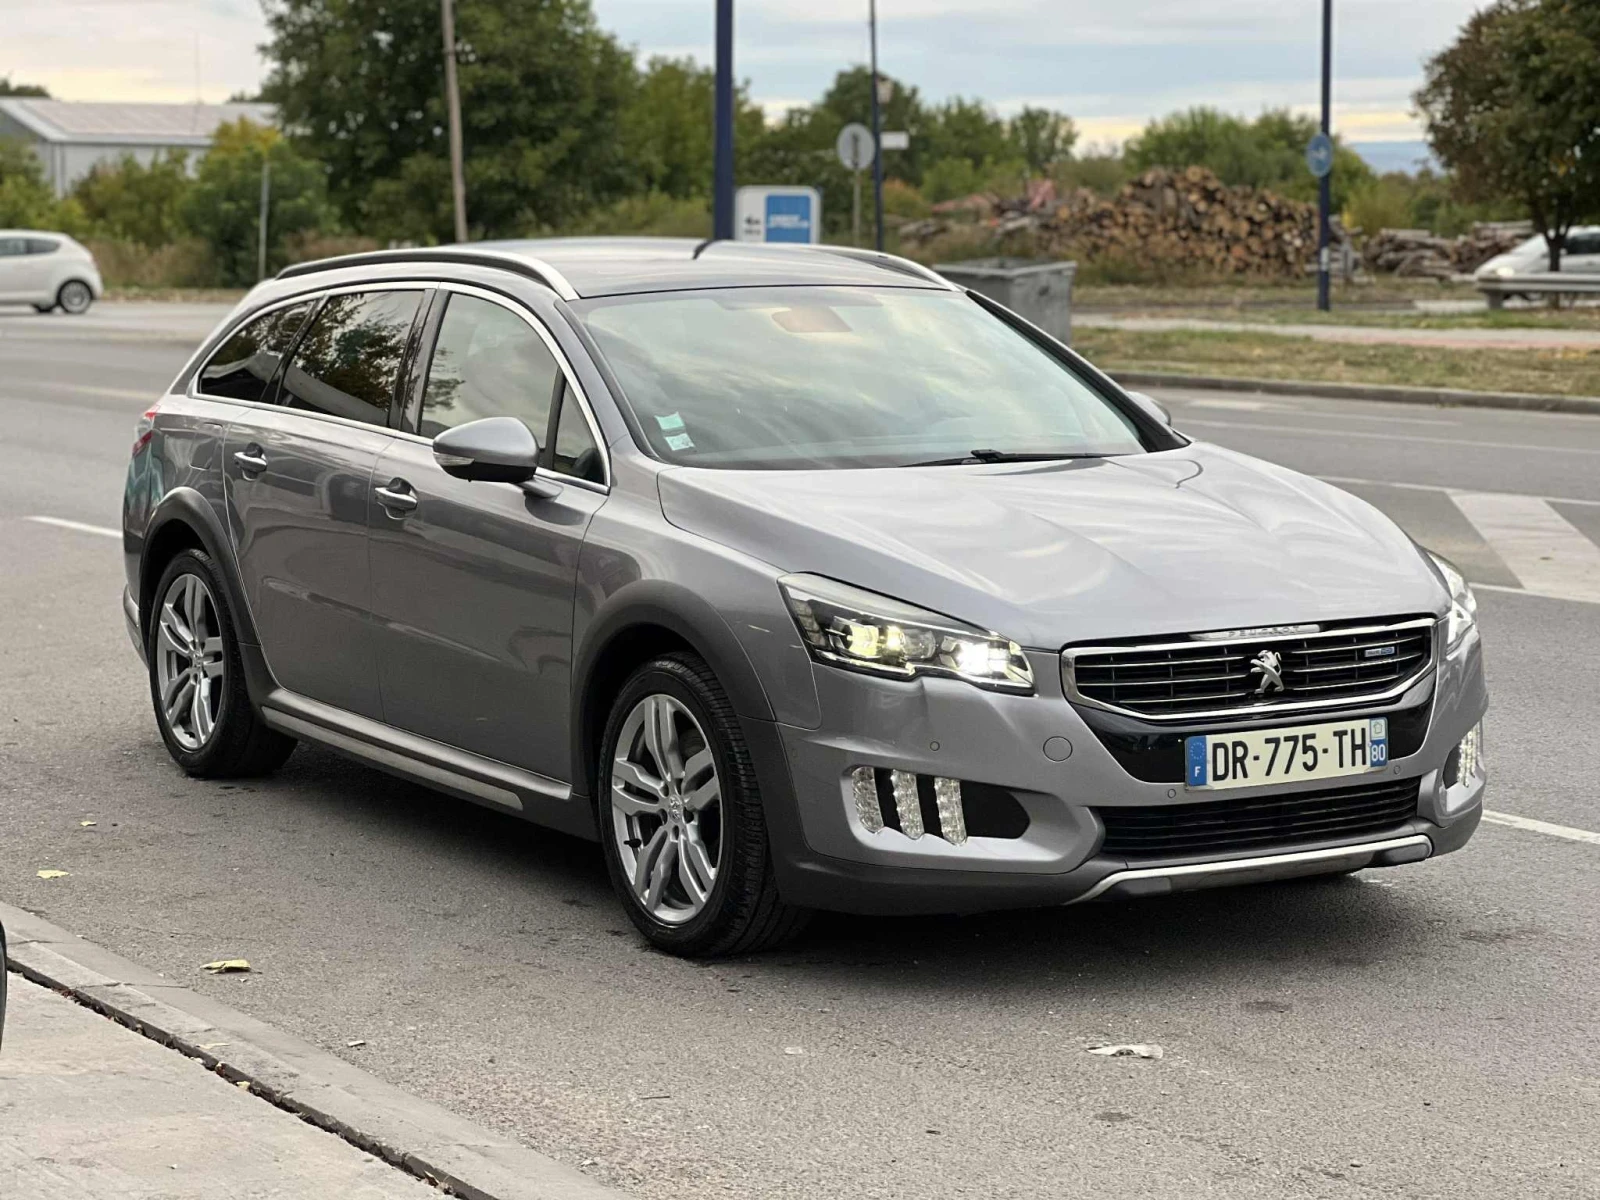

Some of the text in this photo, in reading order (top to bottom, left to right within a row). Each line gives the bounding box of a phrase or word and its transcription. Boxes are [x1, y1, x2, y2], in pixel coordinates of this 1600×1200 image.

[1194, 727, 1386, 782] F DR-775-TH 80
